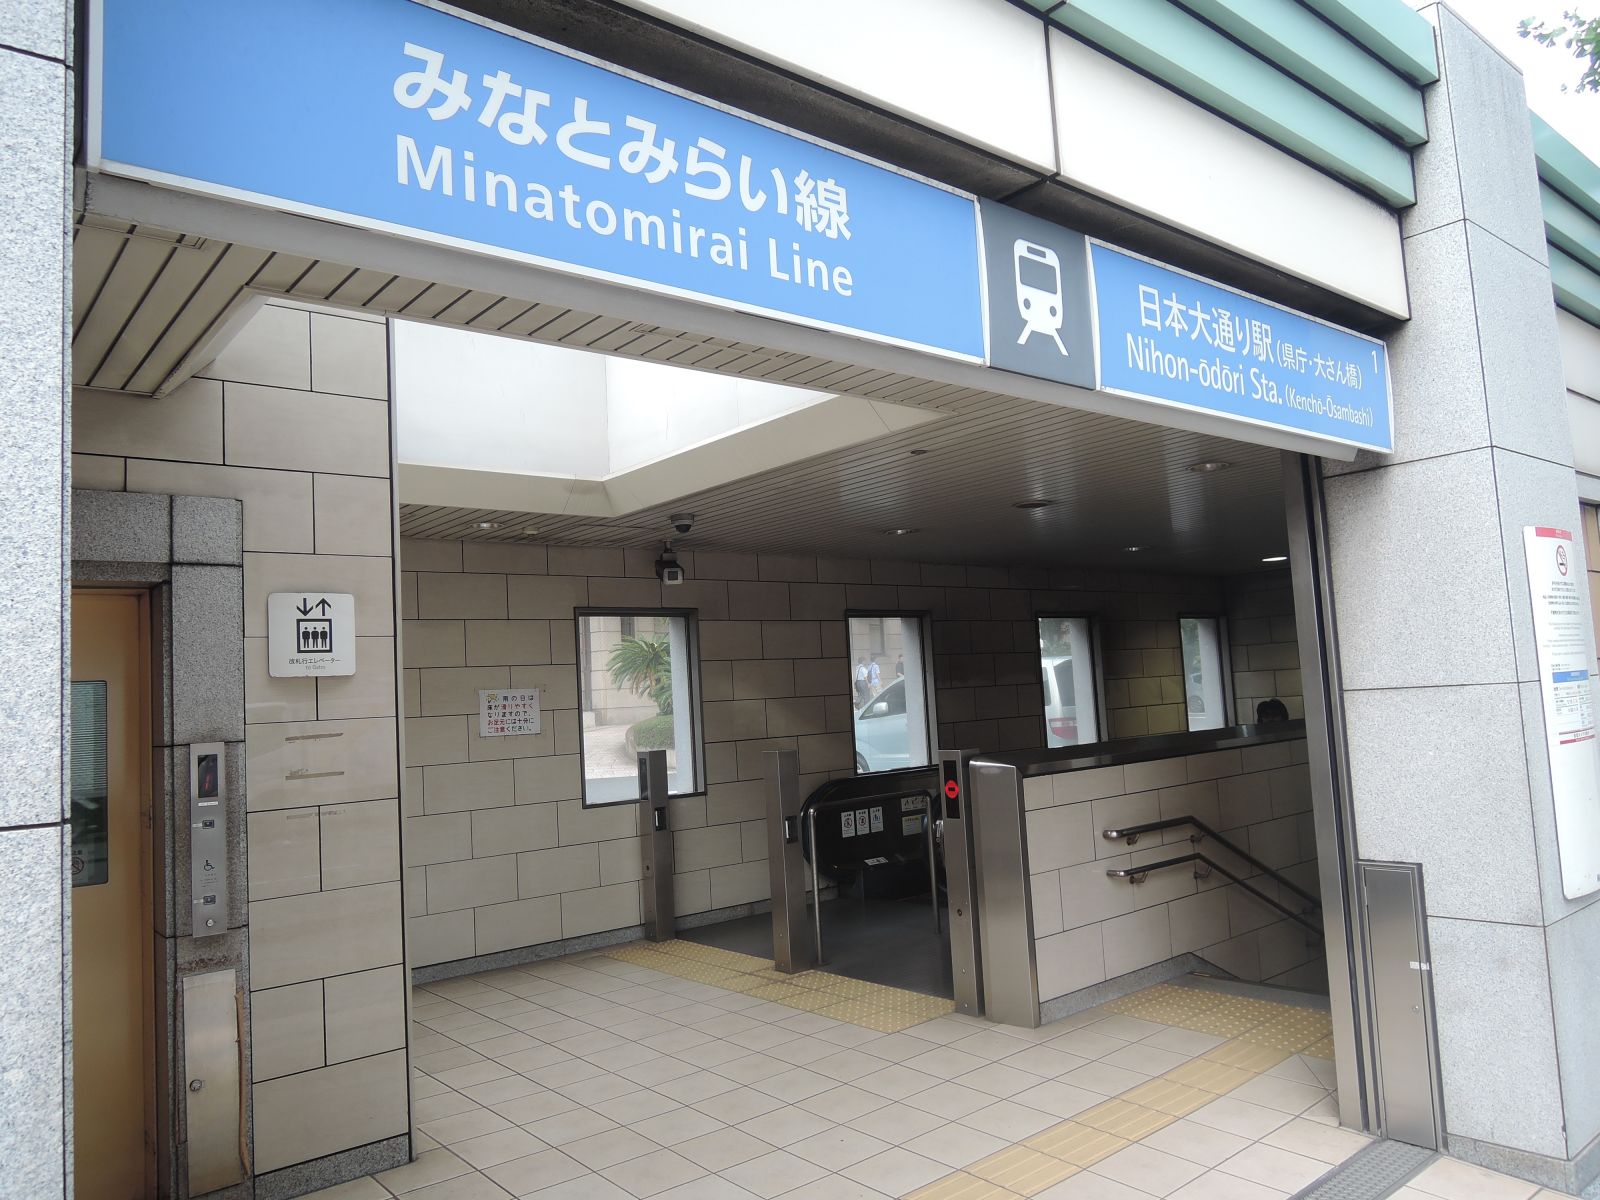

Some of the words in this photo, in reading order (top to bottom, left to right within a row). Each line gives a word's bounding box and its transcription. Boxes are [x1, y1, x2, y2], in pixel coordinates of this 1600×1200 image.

[393, 42, 852, 241] みなとみらい線
[396, 134, 748, 270] Minatomirai
[768, 237, 854, 297] Line
[1138, 284, 1274, 364] 日本大通り駅
[1371, 350, 1379, 374] 1
[1126, 332, 1245, 395] Nihon-ōdōri
[1249, 367, 1283, 404] Sta.
[1285, 384, 1374, 427] (Kenchō-Ōsambashi)
